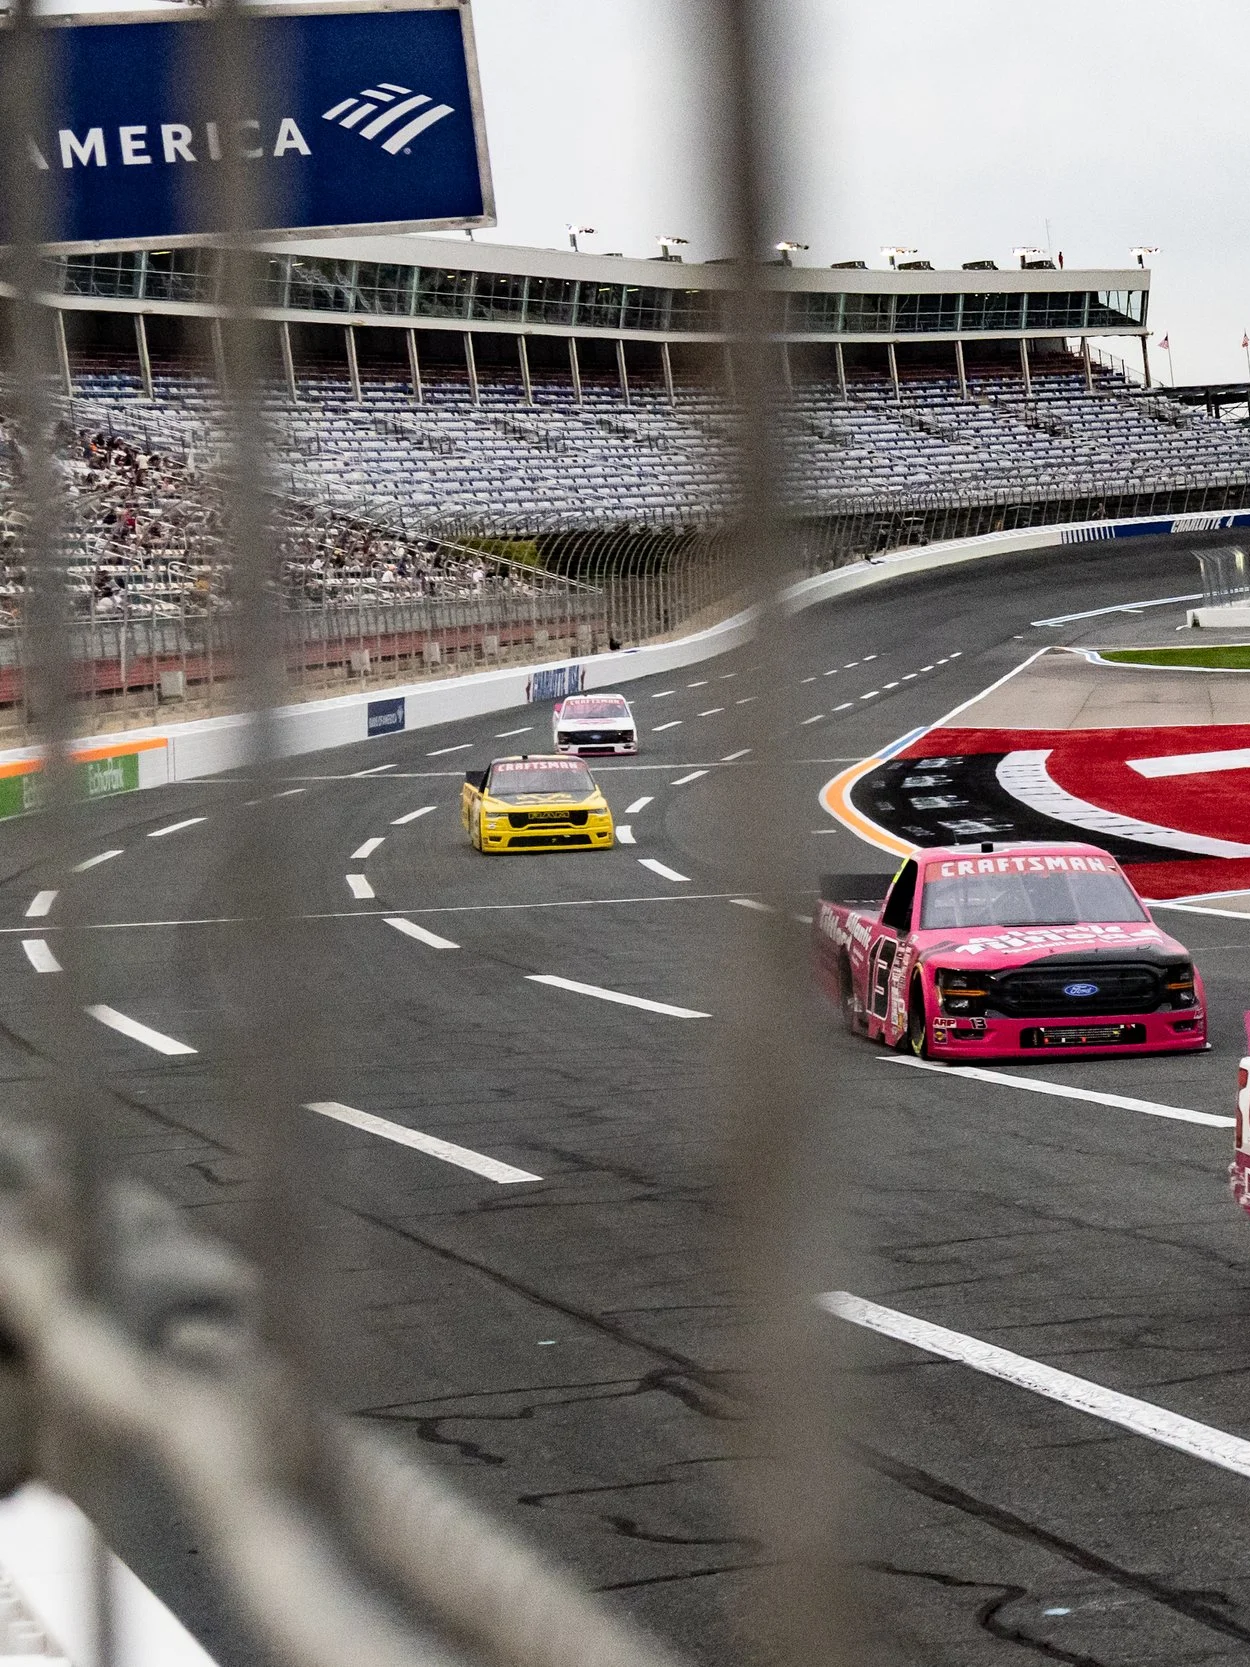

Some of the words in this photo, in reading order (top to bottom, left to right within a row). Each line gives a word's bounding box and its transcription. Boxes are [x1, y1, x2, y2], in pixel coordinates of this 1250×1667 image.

[498, 761, 578, 772] CRAFTSMAN
[942, 856, 1107, 878] CRAFTSMAN
[933, 1018, 956, 1027] ARP
[970, 1017, 987, 1029] 13
